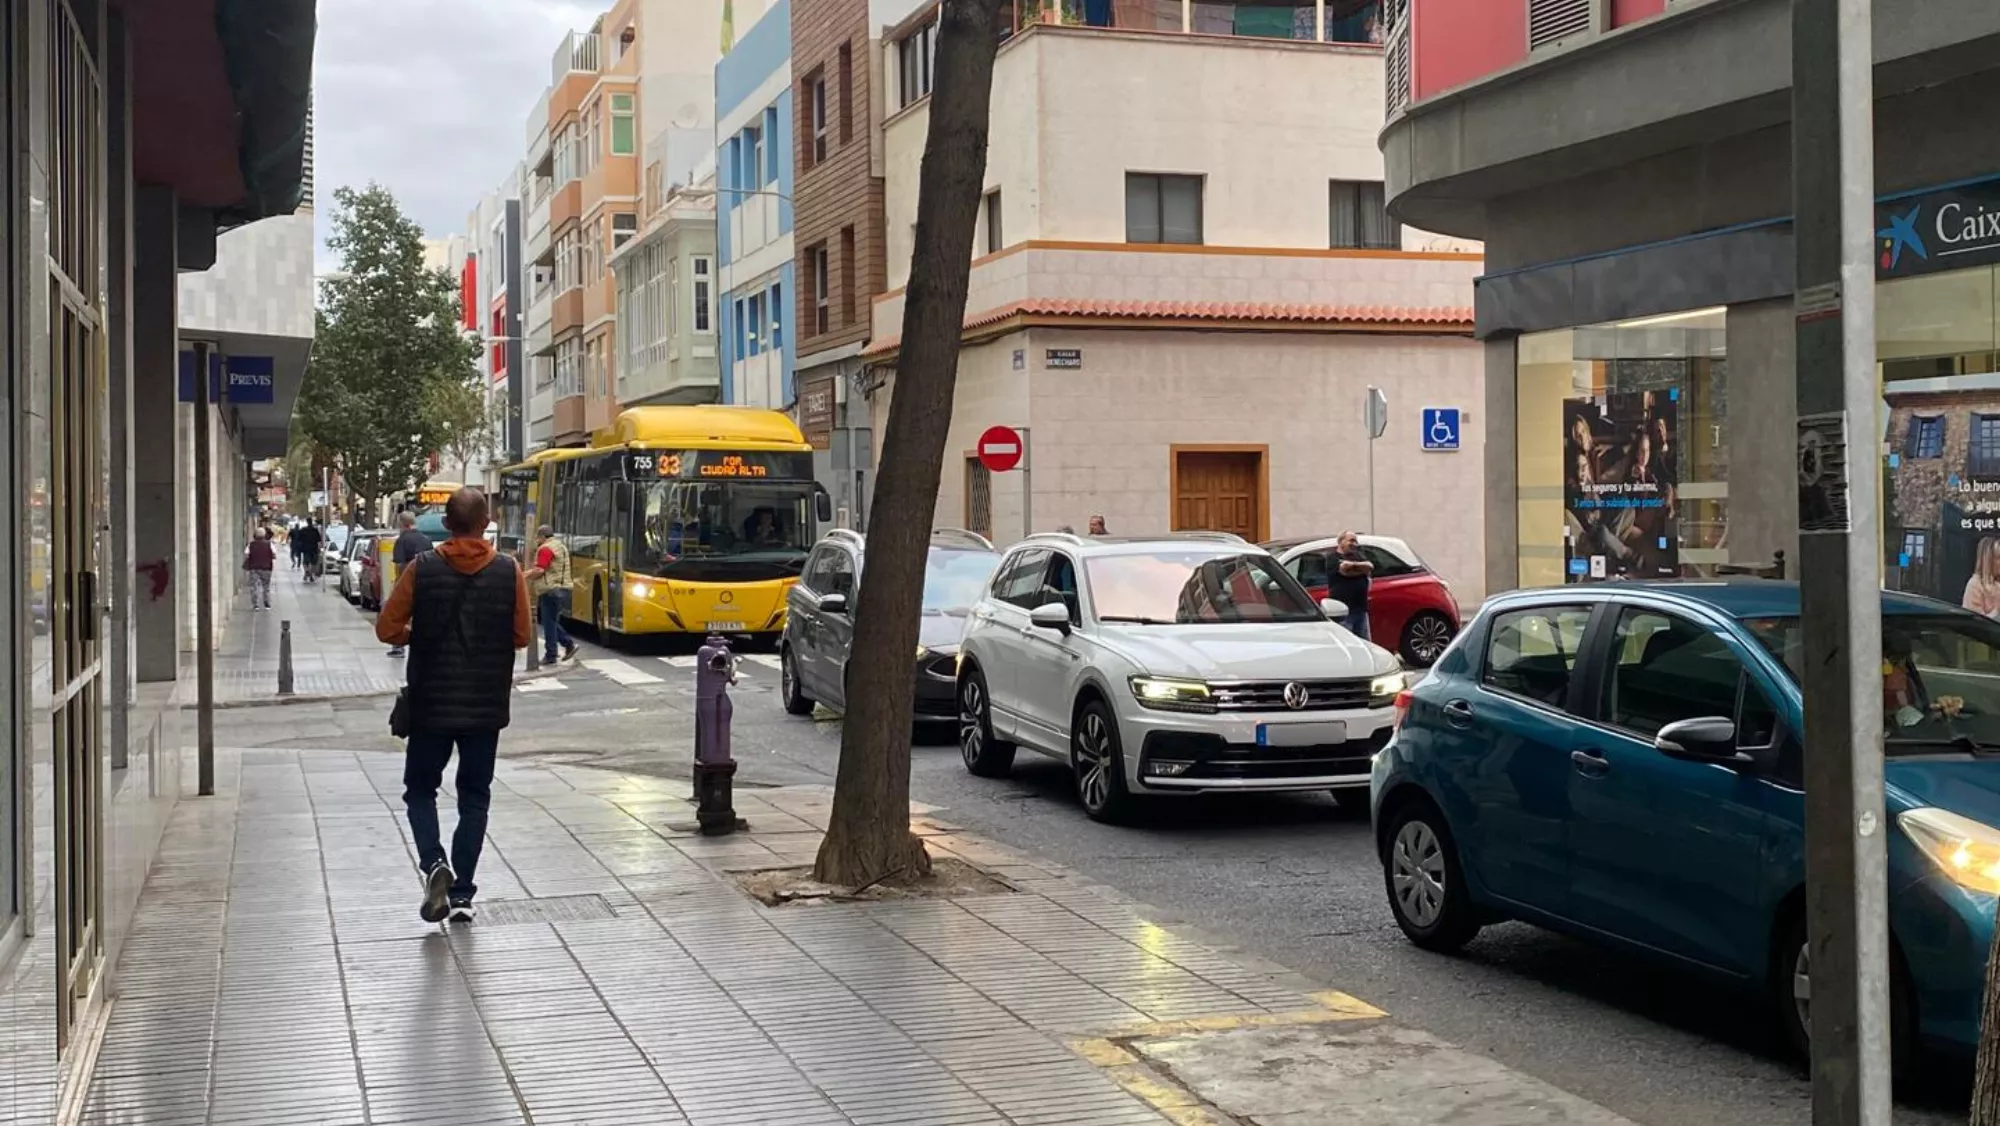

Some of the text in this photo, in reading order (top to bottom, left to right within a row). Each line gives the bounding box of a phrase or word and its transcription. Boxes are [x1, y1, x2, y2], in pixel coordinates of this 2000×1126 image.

[229, 372, 272, 386] PREVIS
[633, 456, 652, 470] 755
[658, 455, 681, 475] 33
[722, 455, 742, 466] POR
[700, 465, 766, 477] CIUDAD ALTA
[1581, 482, 1591, 492] Tus
[1592, 483, 1617, 495] seguros
[1618, 484, 1623, 494] y
[1624, 482, 1632, 492] tu
[1959, 480, 1971, 492] Lo
[1966, 501, 1974, 511] a
[1960, 518, 1973, 529] es
[1974, 518, 1995, 532] que
